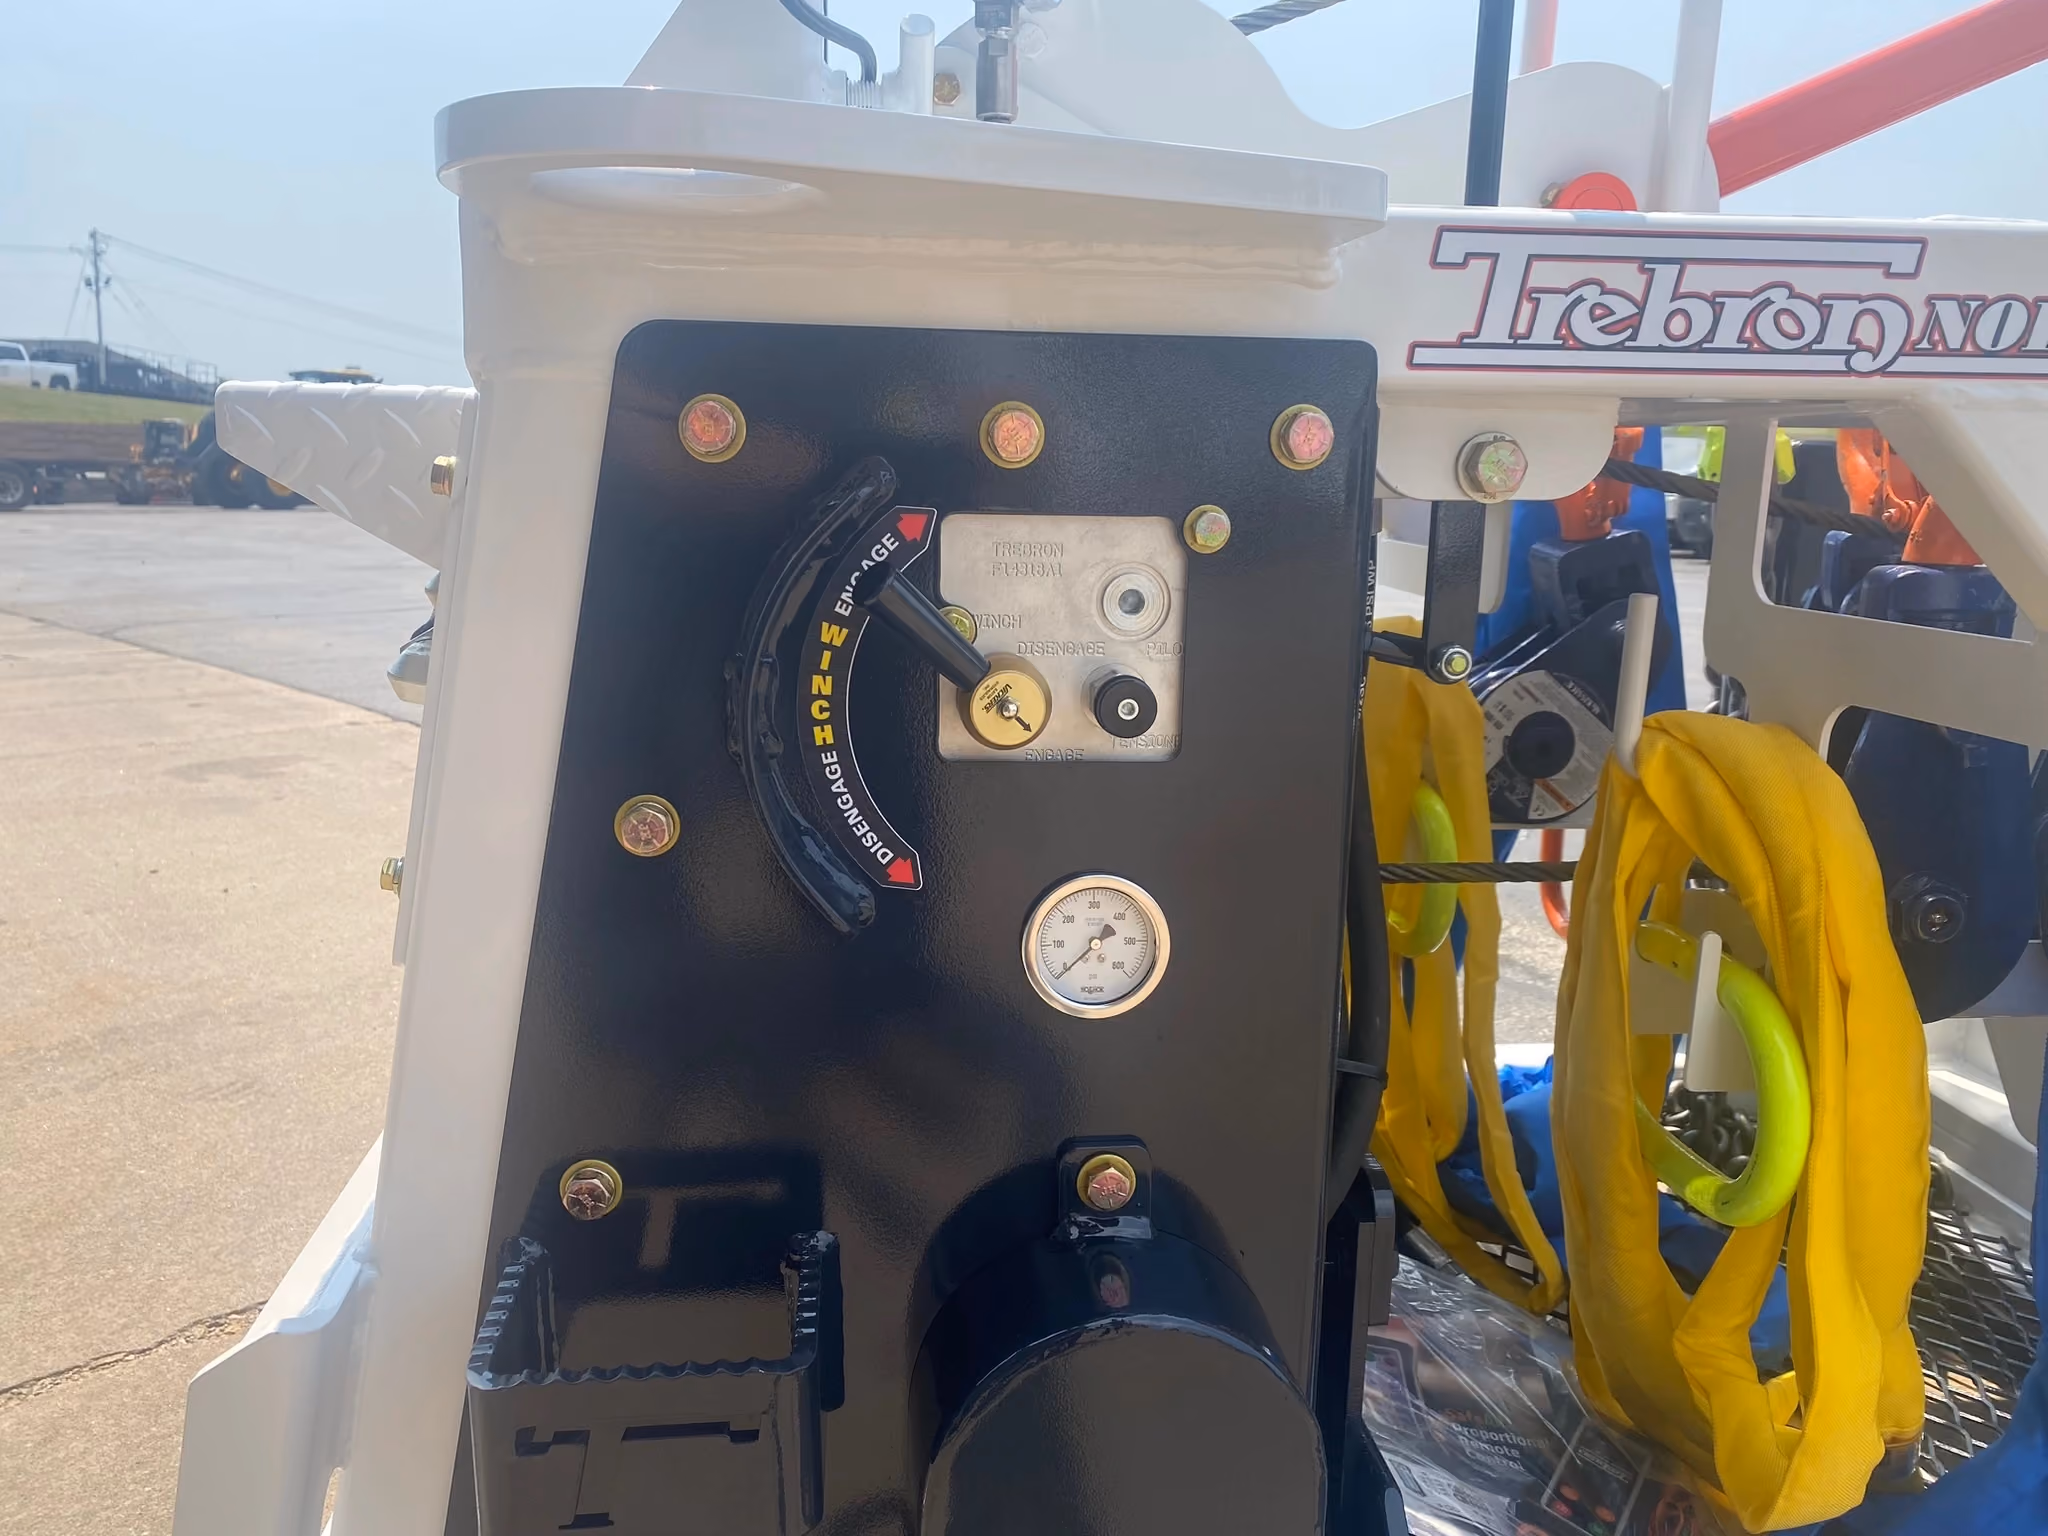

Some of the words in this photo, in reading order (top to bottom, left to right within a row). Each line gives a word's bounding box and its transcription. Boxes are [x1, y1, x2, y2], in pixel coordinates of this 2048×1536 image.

[1430, 225, 1928, 377] Trebron
[992, 541, 1064, 557] TREBRON
[1017, 641, 1106, 656] DISENGAGE
[811, 621, 849, 746] WINCH
[1025, 749, 1085, 761] ENGAGE
[821, 750, 894, 866] DISENGAGE
[1088, 901, 1101, 910] 300
[1062, 915, 1075, 924] 200
[1113, 912, 1126, 921] 400
[1053, 940, 1065, 949] 100
[1123, 936, 1136, 946] 500
